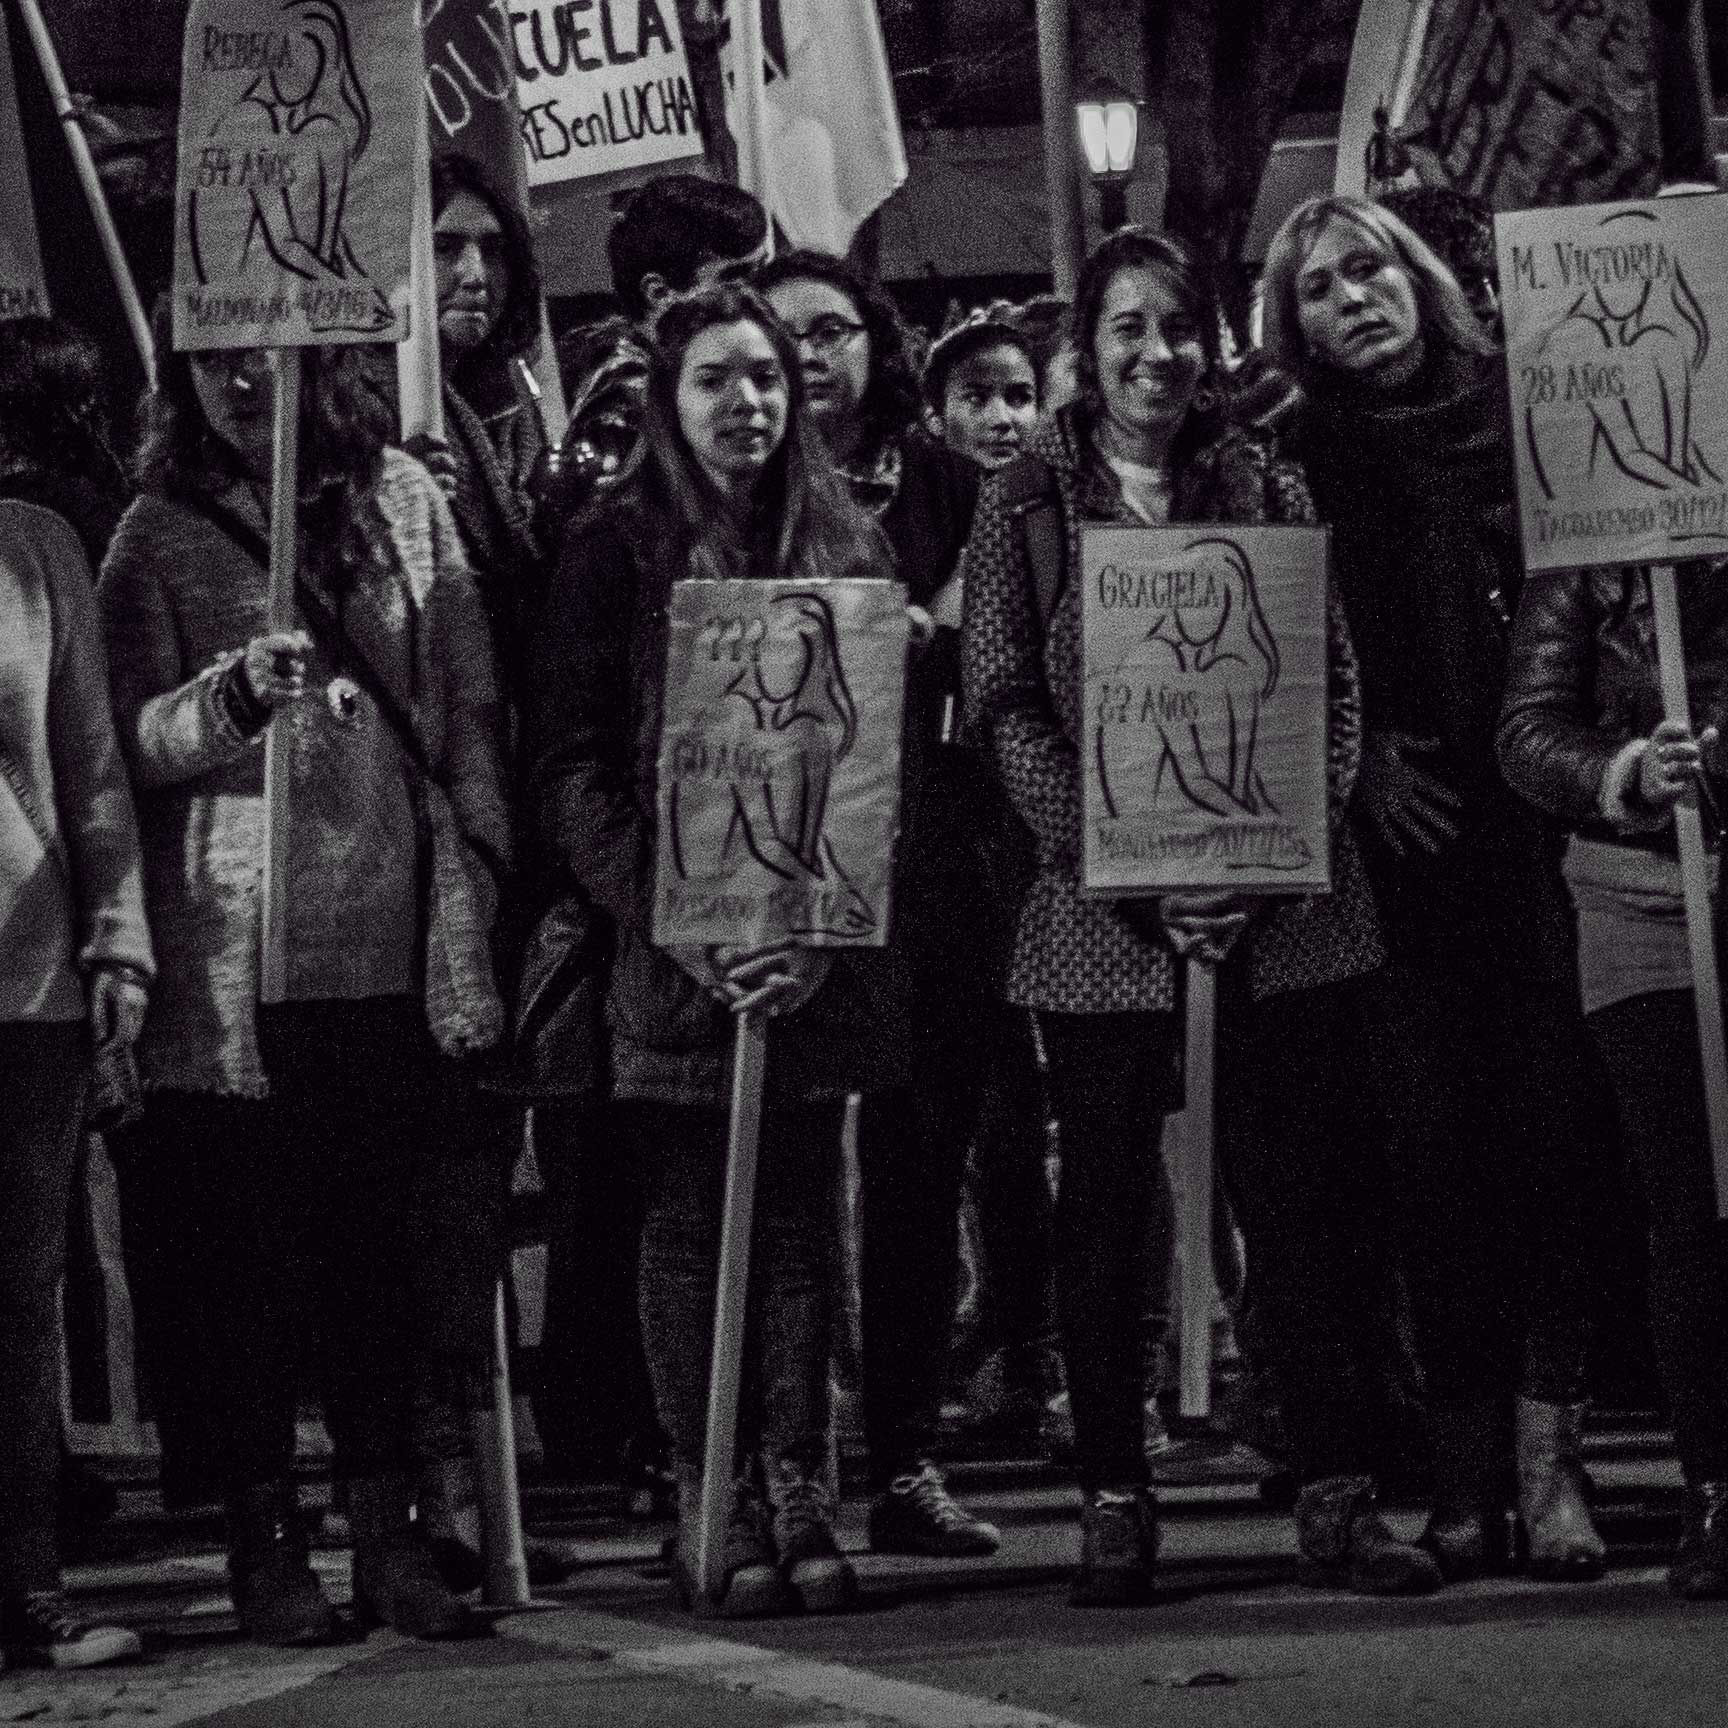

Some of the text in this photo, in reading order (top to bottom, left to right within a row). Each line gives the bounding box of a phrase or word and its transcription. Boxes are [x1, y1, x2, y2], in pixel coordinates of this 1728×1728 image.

[239, 147, 297, 187] AÑOS
[1512, 239, 1672, 291] M. VICTORIA
[1522, 360, 1627, 406] 28 AÑOS
[1098, 563, 1219, 610] GRACIELA
[1139, 683, 1200, 723] AÑOS
